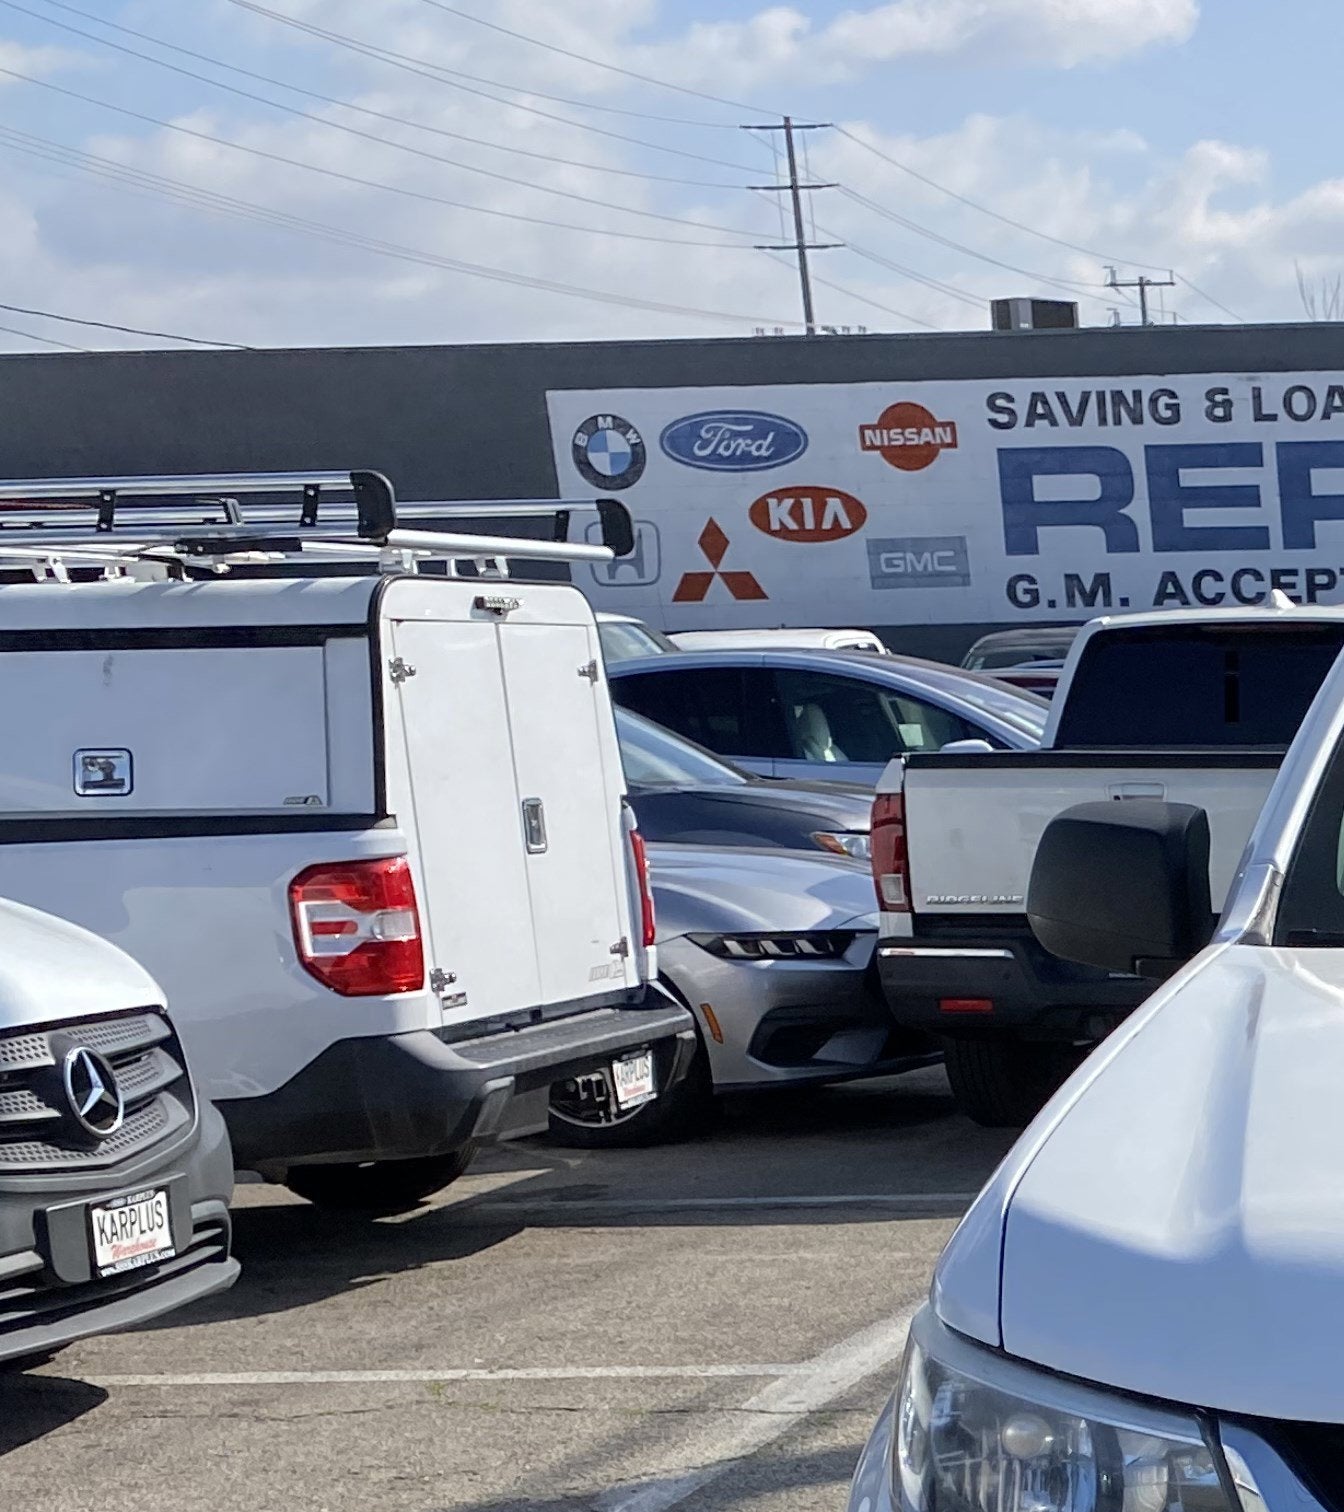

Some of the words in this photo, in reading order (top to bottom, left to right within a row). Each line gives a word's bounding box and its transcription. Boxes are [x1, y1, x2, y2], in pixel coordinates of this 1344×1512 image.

[986, 387, 1181, 430] SAVING
[1204, 386, 1233, 423] &
[575, 416, 642, 447] BMW
[693, 422, 775, 457] Ford
[863, 426, 952, 447] NISSAN
[766, 497, 853, 532] KIA
[880, 550, 957, 574] GMC
[1005, 572, 1131, 610] G.M.
[926, 895, 1025, 906] RIDGELINE
[97, 1199, 164, 1247] KARPLUS
